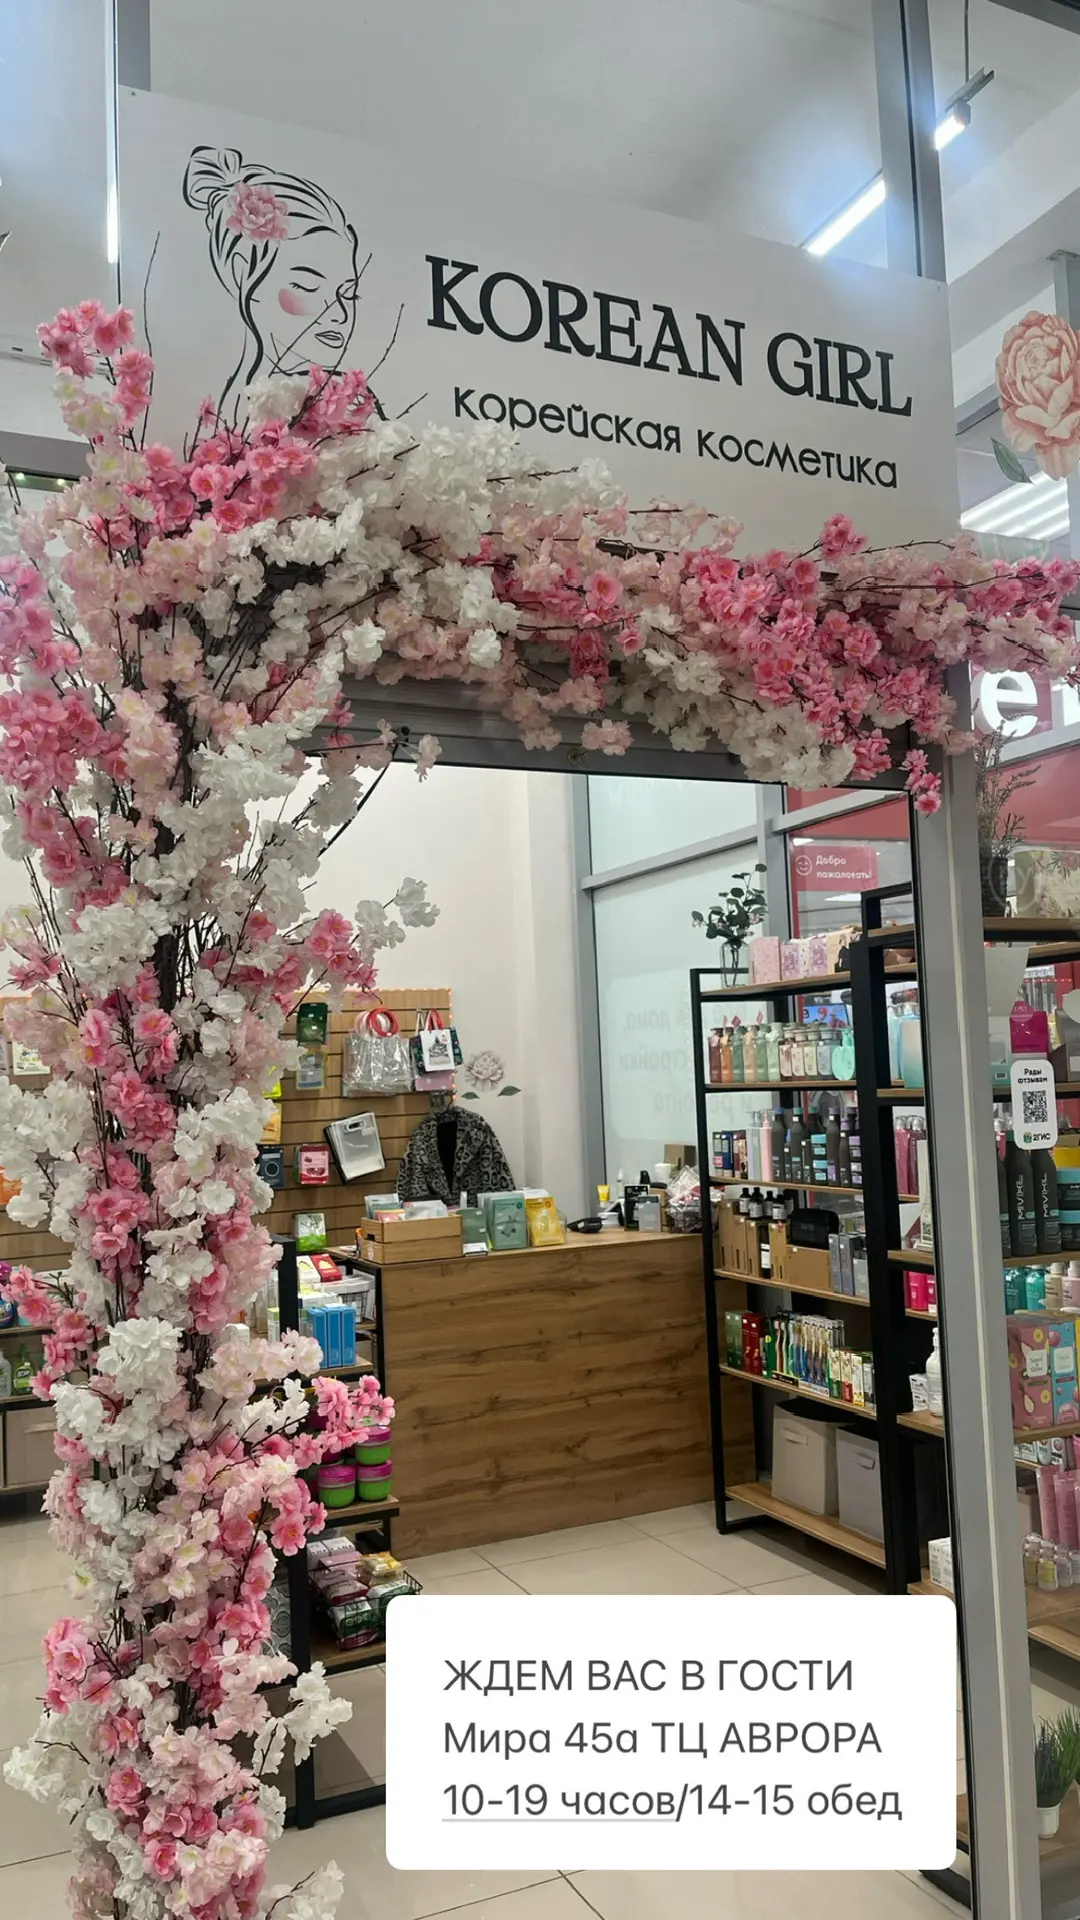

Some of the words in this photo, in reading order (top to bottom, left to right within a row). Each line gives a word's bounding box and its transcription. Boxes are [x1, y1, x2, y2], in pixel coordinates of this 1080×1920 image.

[425, 254, 745, 386] KOREAN
[767, 332, 913, 417] GIRL
[454, 386, 682, 454] корейская
[697, 429, 897, 489] косметика
[815, 854, 847, 868] Добро
[1024, 1068, 1042, 1076] Рады
[1033, 1133, 1051, 1141] 2ГИС
